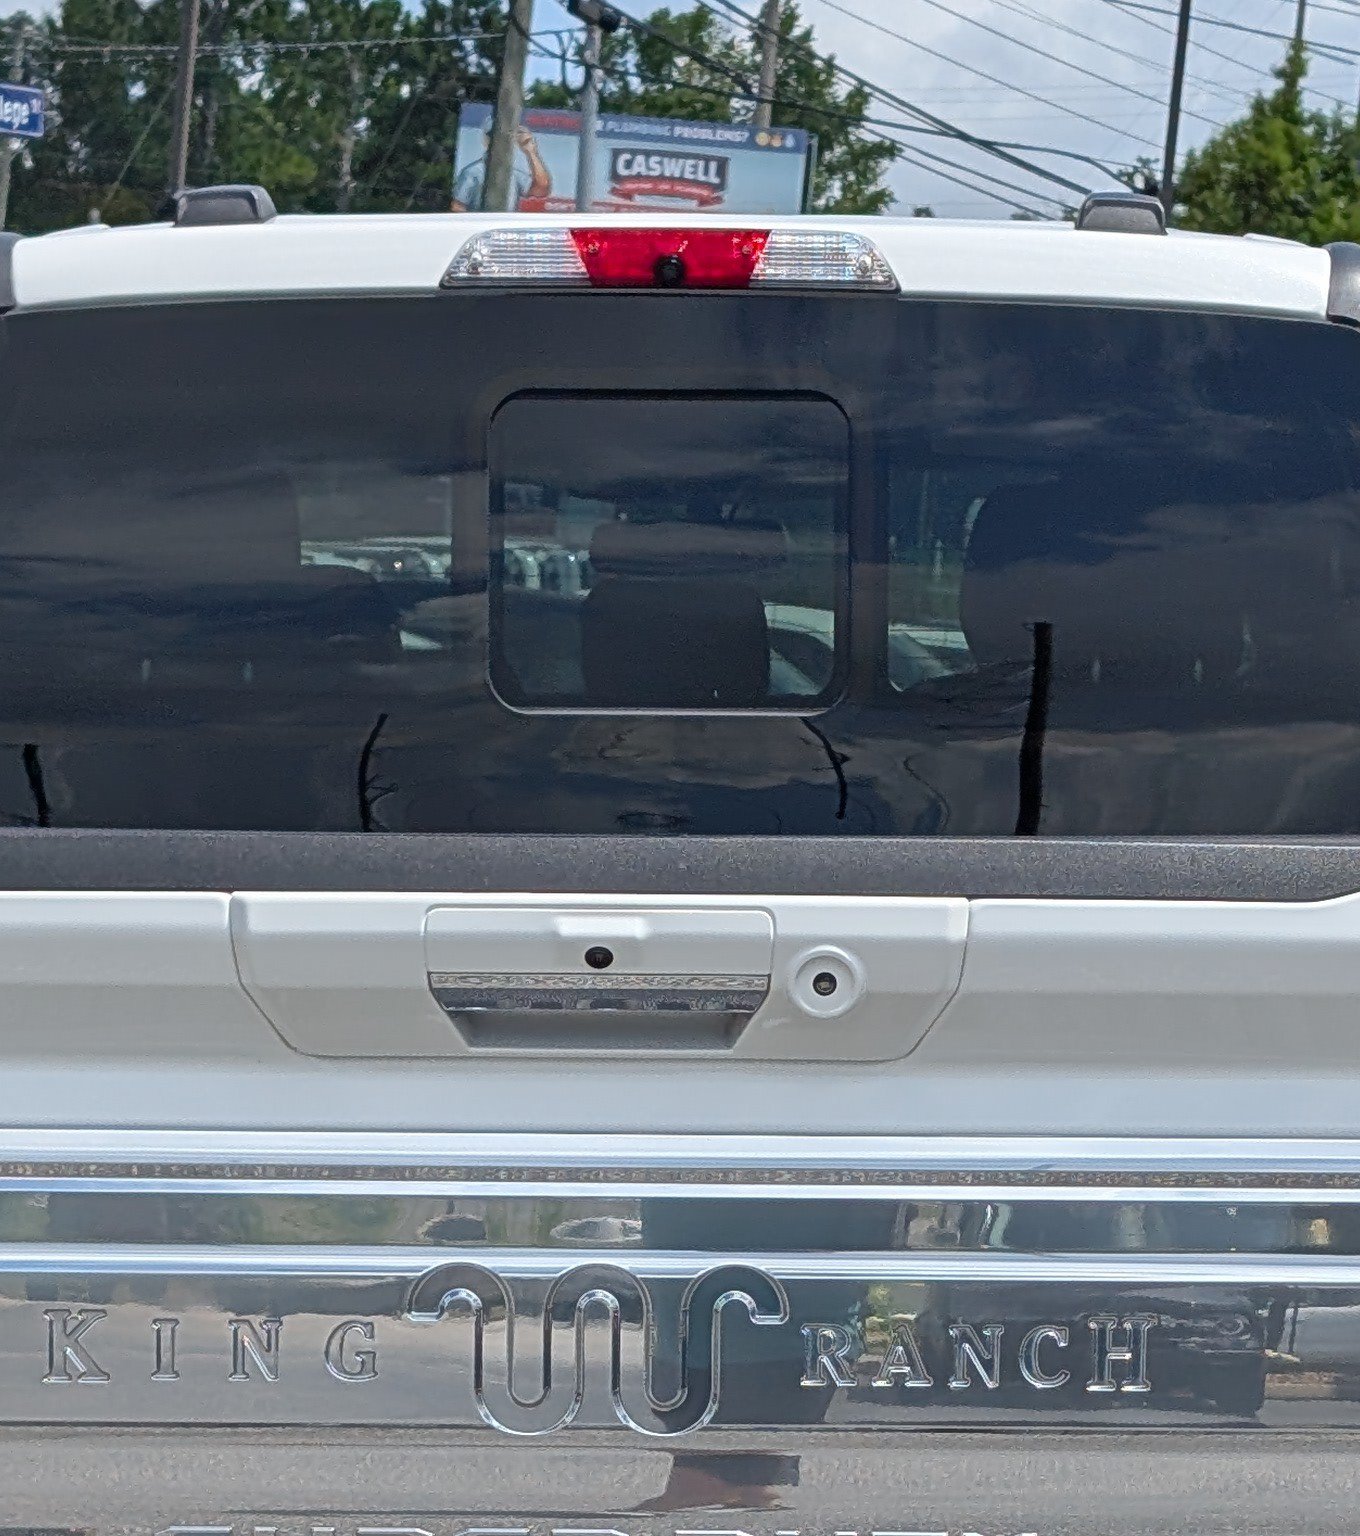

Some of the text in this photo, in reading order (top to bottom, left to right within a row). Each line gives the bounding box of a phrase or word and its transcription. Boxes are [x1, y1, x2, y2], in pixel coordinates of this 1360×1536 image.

[616, 153, 721, 184] CASWELL
[42, 1308, 1161, 1392] KING RANCH
